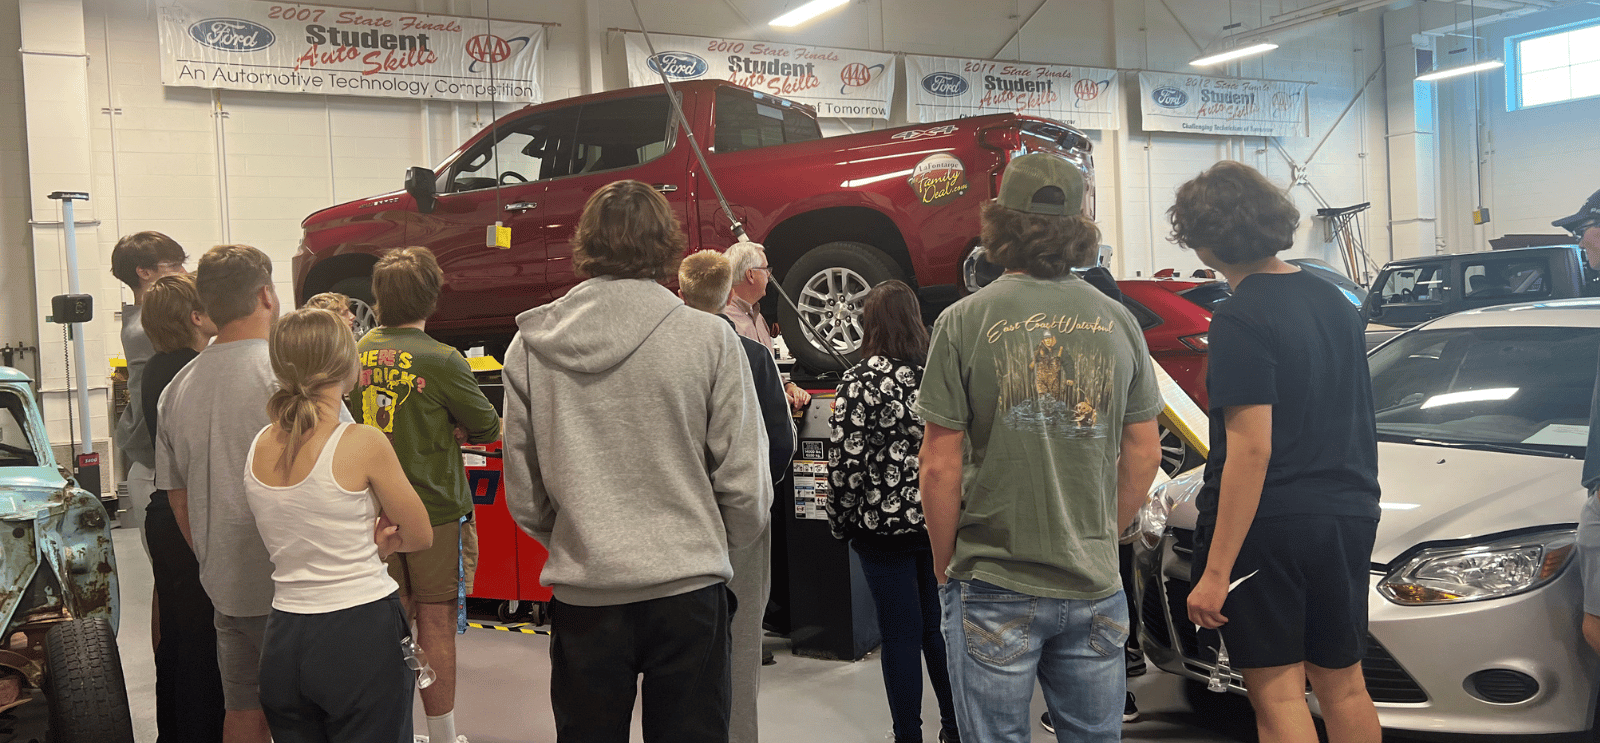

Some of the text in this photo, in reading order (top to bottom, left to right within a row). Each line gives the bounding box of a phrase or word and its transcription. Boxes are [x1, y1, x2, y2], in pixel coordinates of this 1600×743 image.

[267, 6, 463, 33] 2007 State Finals
[206, 21, 259, 47] Ford
[305, 24, 430, 52] Student
[294, 43, 439, 76] Auto Skills
[470, 34, 508, 63] AAA
[707, 40, 840, 62] 2010 State Finals
[661, 54, 698, 76] Ford
[727, 55, 815, 78] Student
[842, 63, 870, 87] AAA
[964, 61, 1072, 79] 2011 State Finals
[178, 64, 533, 97] An Automotive Technology Competition
[727, 70, 821, 95] Auto Skills
[930, 75, 961, 93] Ford
[984, 74, 1054, 94] Student
[1185, 77, 1211, 88] 2012
[978, 89, 1058, 112] Auto Skills
[1158, 90, 1181, 105] Ford
[1200, 88, 1255, 105] Student
[825, 102, 887, 116] Tomorrow
[917, 166, 961, 194] Family
[922, 180, 968, 203] Deal.com
[986, 312, 1115, 344] East Coast Waterfowl
[359, 367, 426, 394] TRICK?
